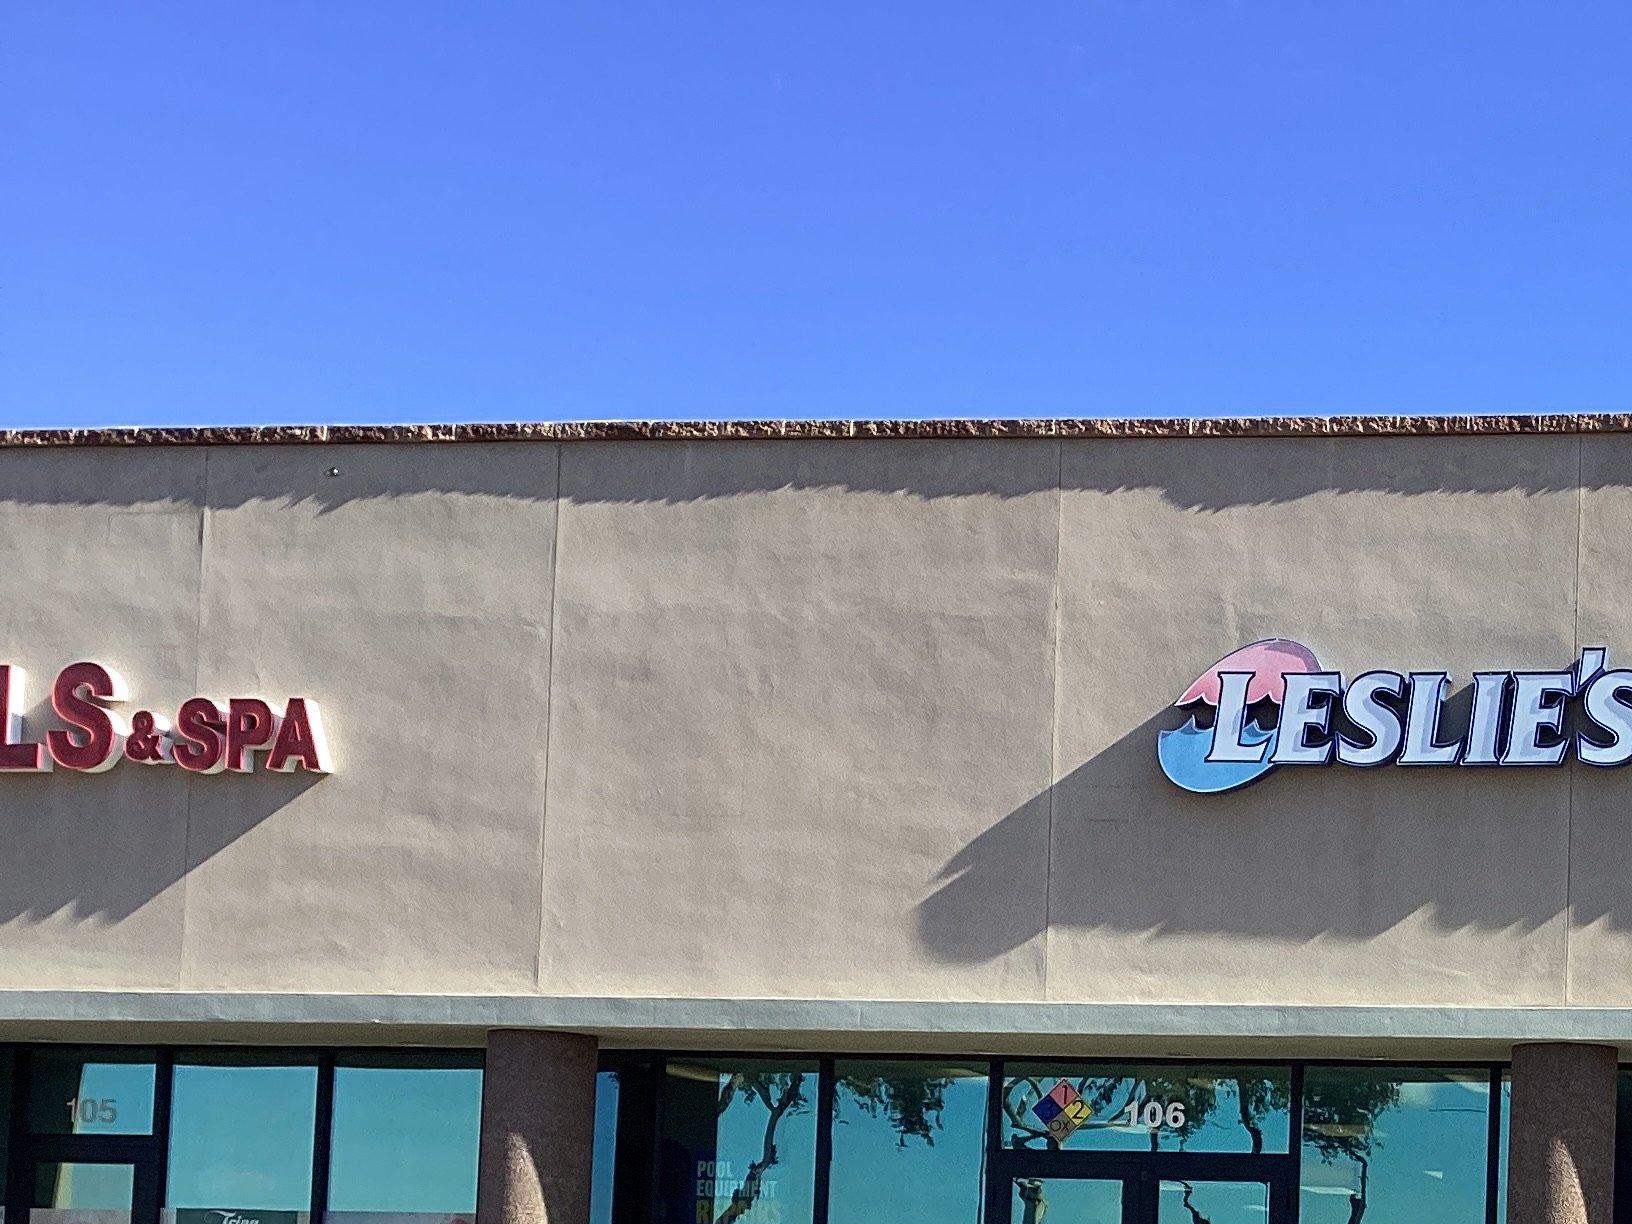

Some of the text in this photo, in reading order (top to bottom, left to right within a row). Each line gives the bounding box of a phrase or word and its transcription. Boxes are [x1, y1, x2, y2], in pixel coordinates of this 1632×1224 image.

[173, 697, 334, 773] SPA
[66, 1098, 118, 1123] 105
[1072, 1100, 1084, 1120] 2
[1125, 1100, 1186, 1128] 106
[697, 1160, 733, 1178] POOL
